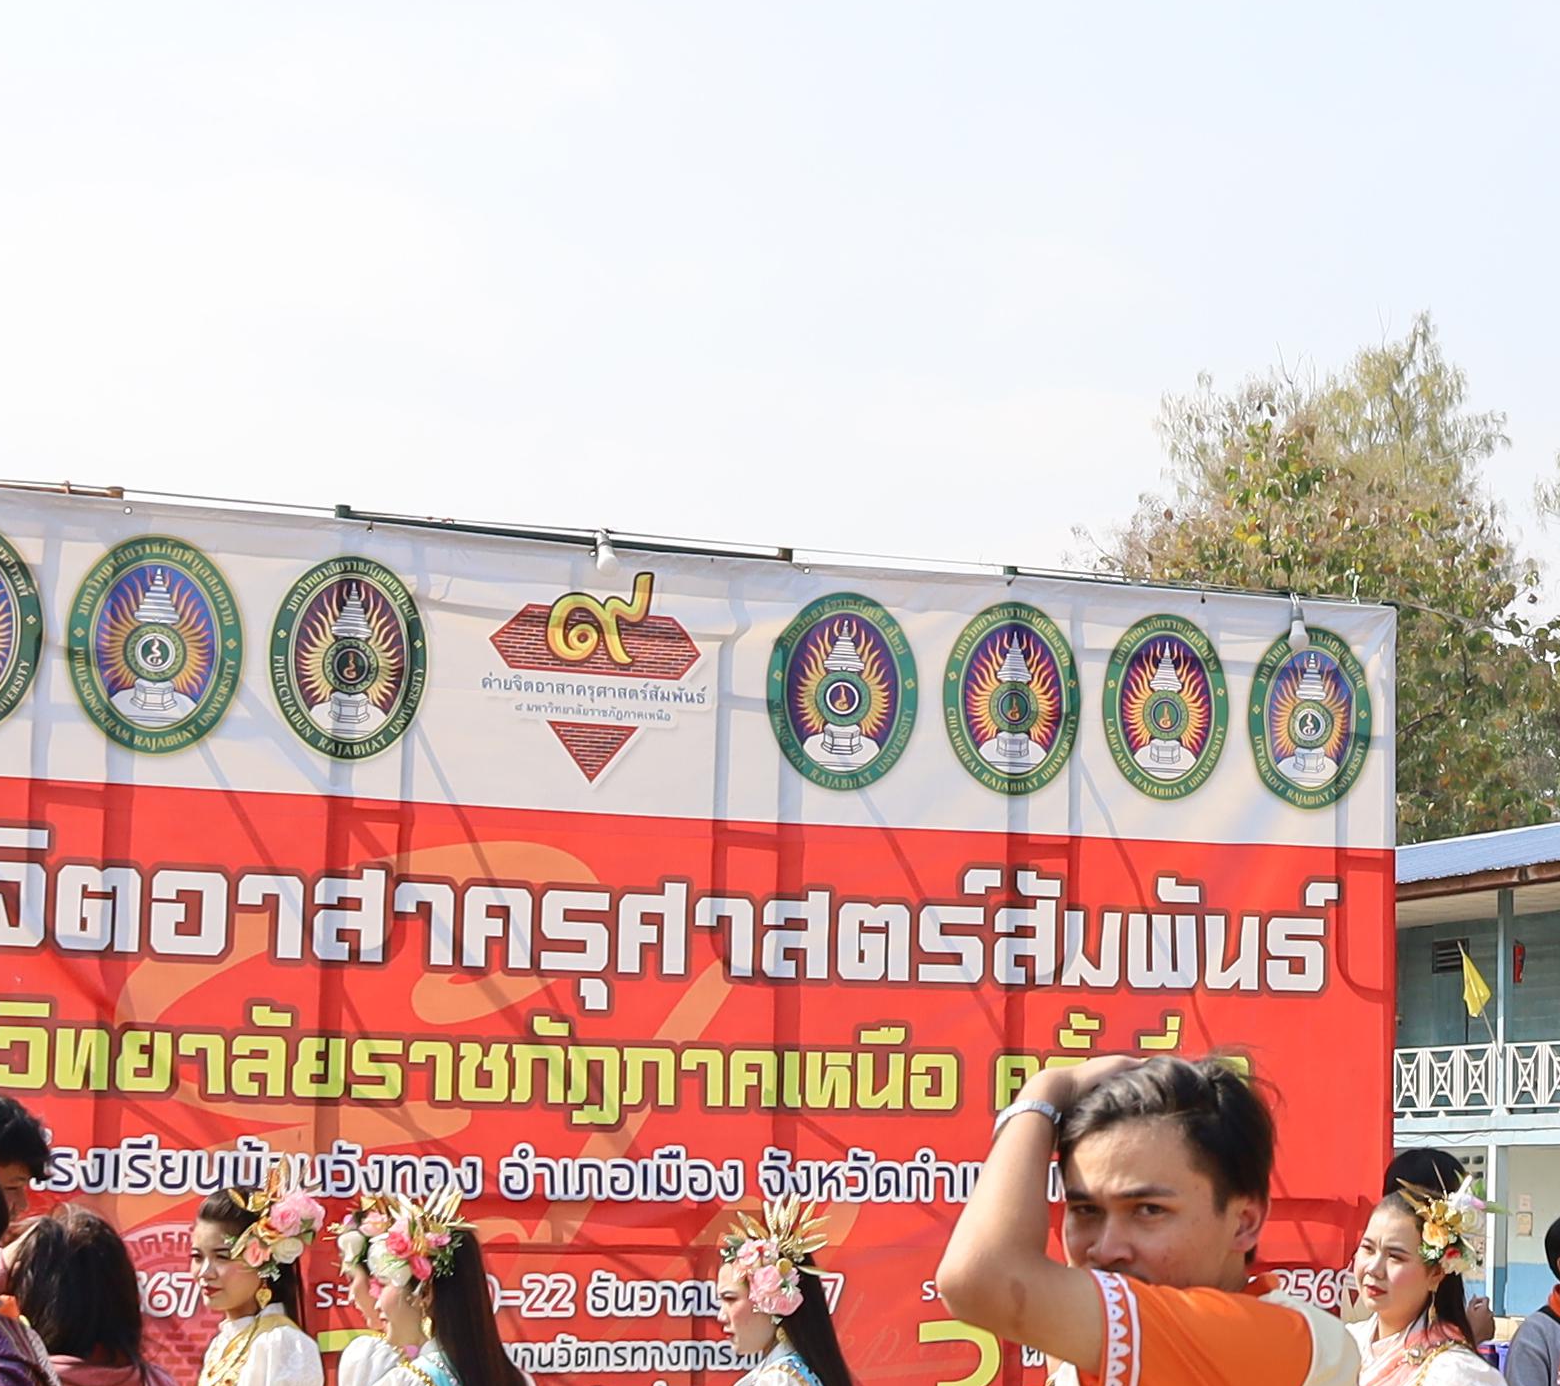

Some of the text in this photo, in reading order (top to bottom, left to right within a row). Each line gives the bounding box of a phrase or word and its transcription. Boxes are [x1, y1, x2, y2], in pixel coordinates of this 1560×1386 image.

[132, 725, 200, 751] RAJABHAT
[199, 658, 239, 728] UNIVERSITY
[273, 654, 426, 757] PHETCHABUN RAJABHAT UNIVERSITY
[481, 671, 708, 706] ค่ายจิตอาสาครุศาสตร์สัมพันธ์
[809, 767, 873, 791] RAJABHAT
[877, 708, 914, 775] UNIVERSITY
[980, 772, 1040, 794] RAJABHAT
[1040, 714, 1078, 783] UNIVERSITY
[1105, 717, 1226, 797] LAMPANG RAJABHAT UNIVERSITY
[1253, 735, 1367, 807] UTTARADIT RAJABHAT UNIVERSITY
[499, 1143, 743, 1203] อำเภอเมือง
[588, 1269, 722, 1318] ธันวาคม
